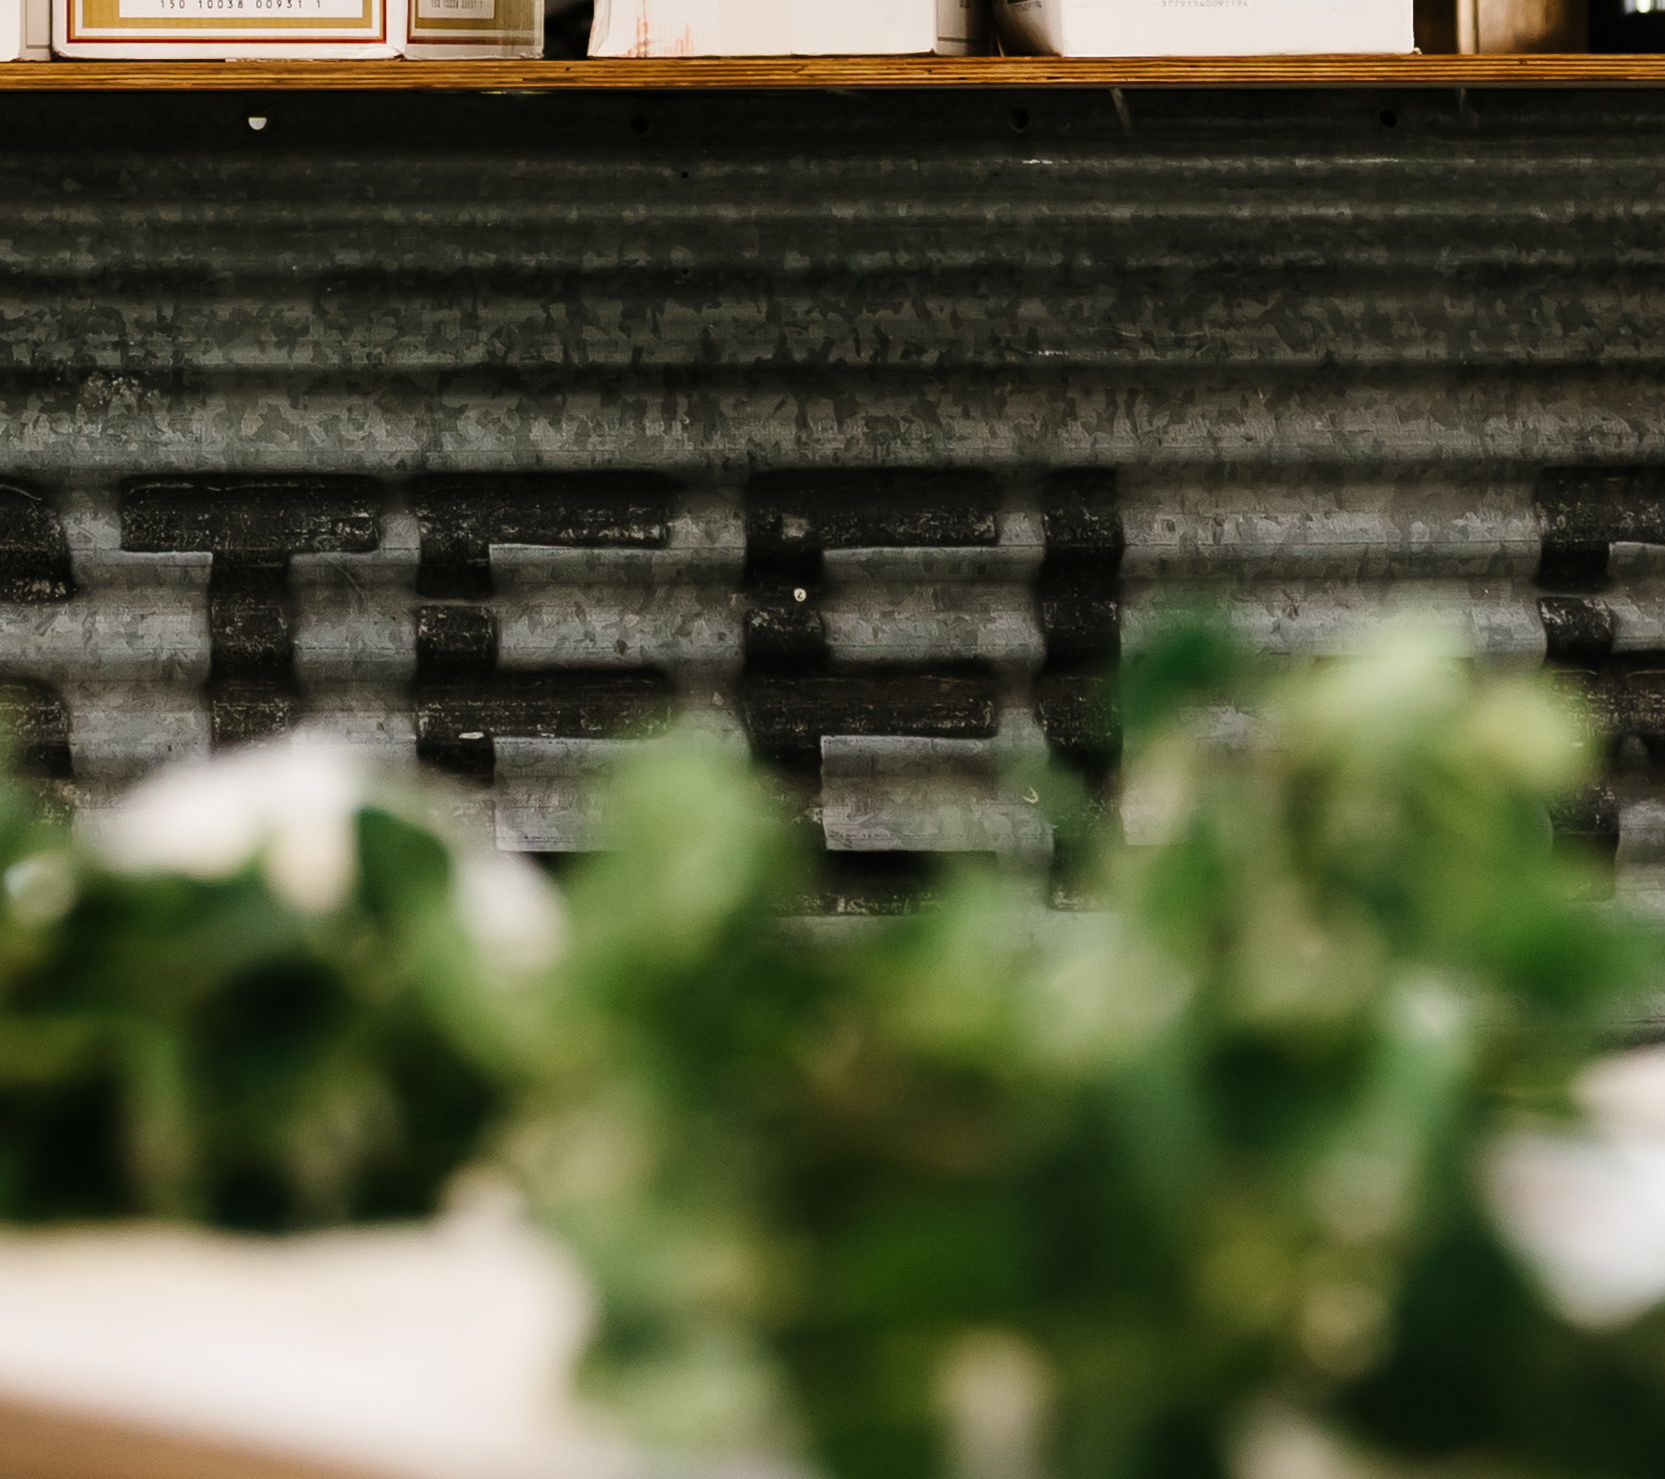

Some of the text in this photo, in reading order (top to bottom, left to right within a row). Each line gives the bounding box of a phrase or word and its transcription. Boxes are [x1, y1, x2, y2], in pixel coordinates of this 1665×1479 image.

[161, 0, 186, 9] 150
[198, 0, 244, 9] 10038
[256, 0, 303, 9] 00931
